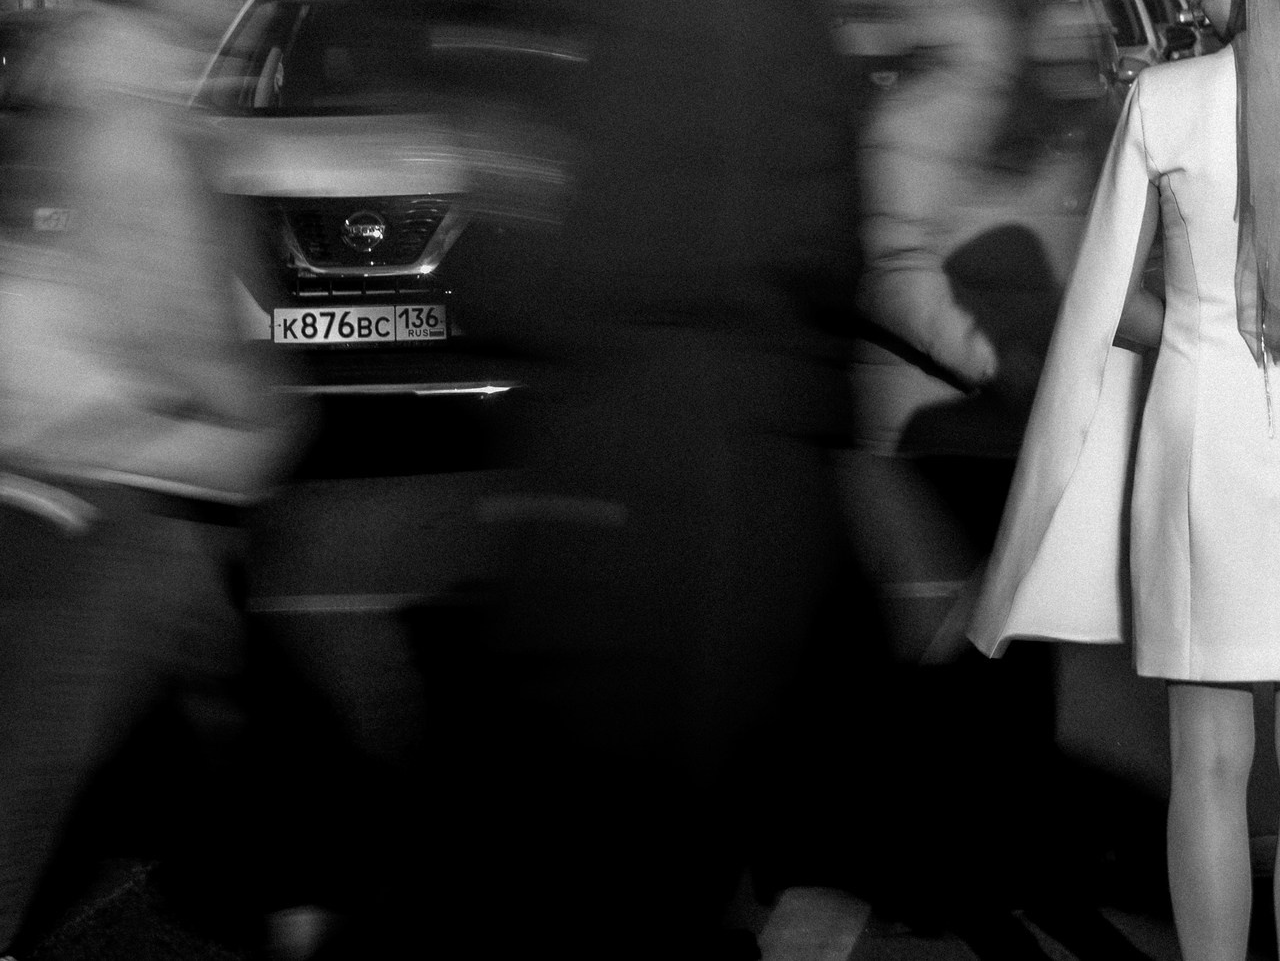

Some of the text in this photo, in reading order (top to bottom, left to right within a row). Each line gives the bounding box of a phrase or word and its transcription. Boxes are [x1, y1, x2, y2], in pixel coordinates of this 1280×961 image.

[282, 307, 439, 339] К876ВС 136
[408, 328, 429, 337] RUS
